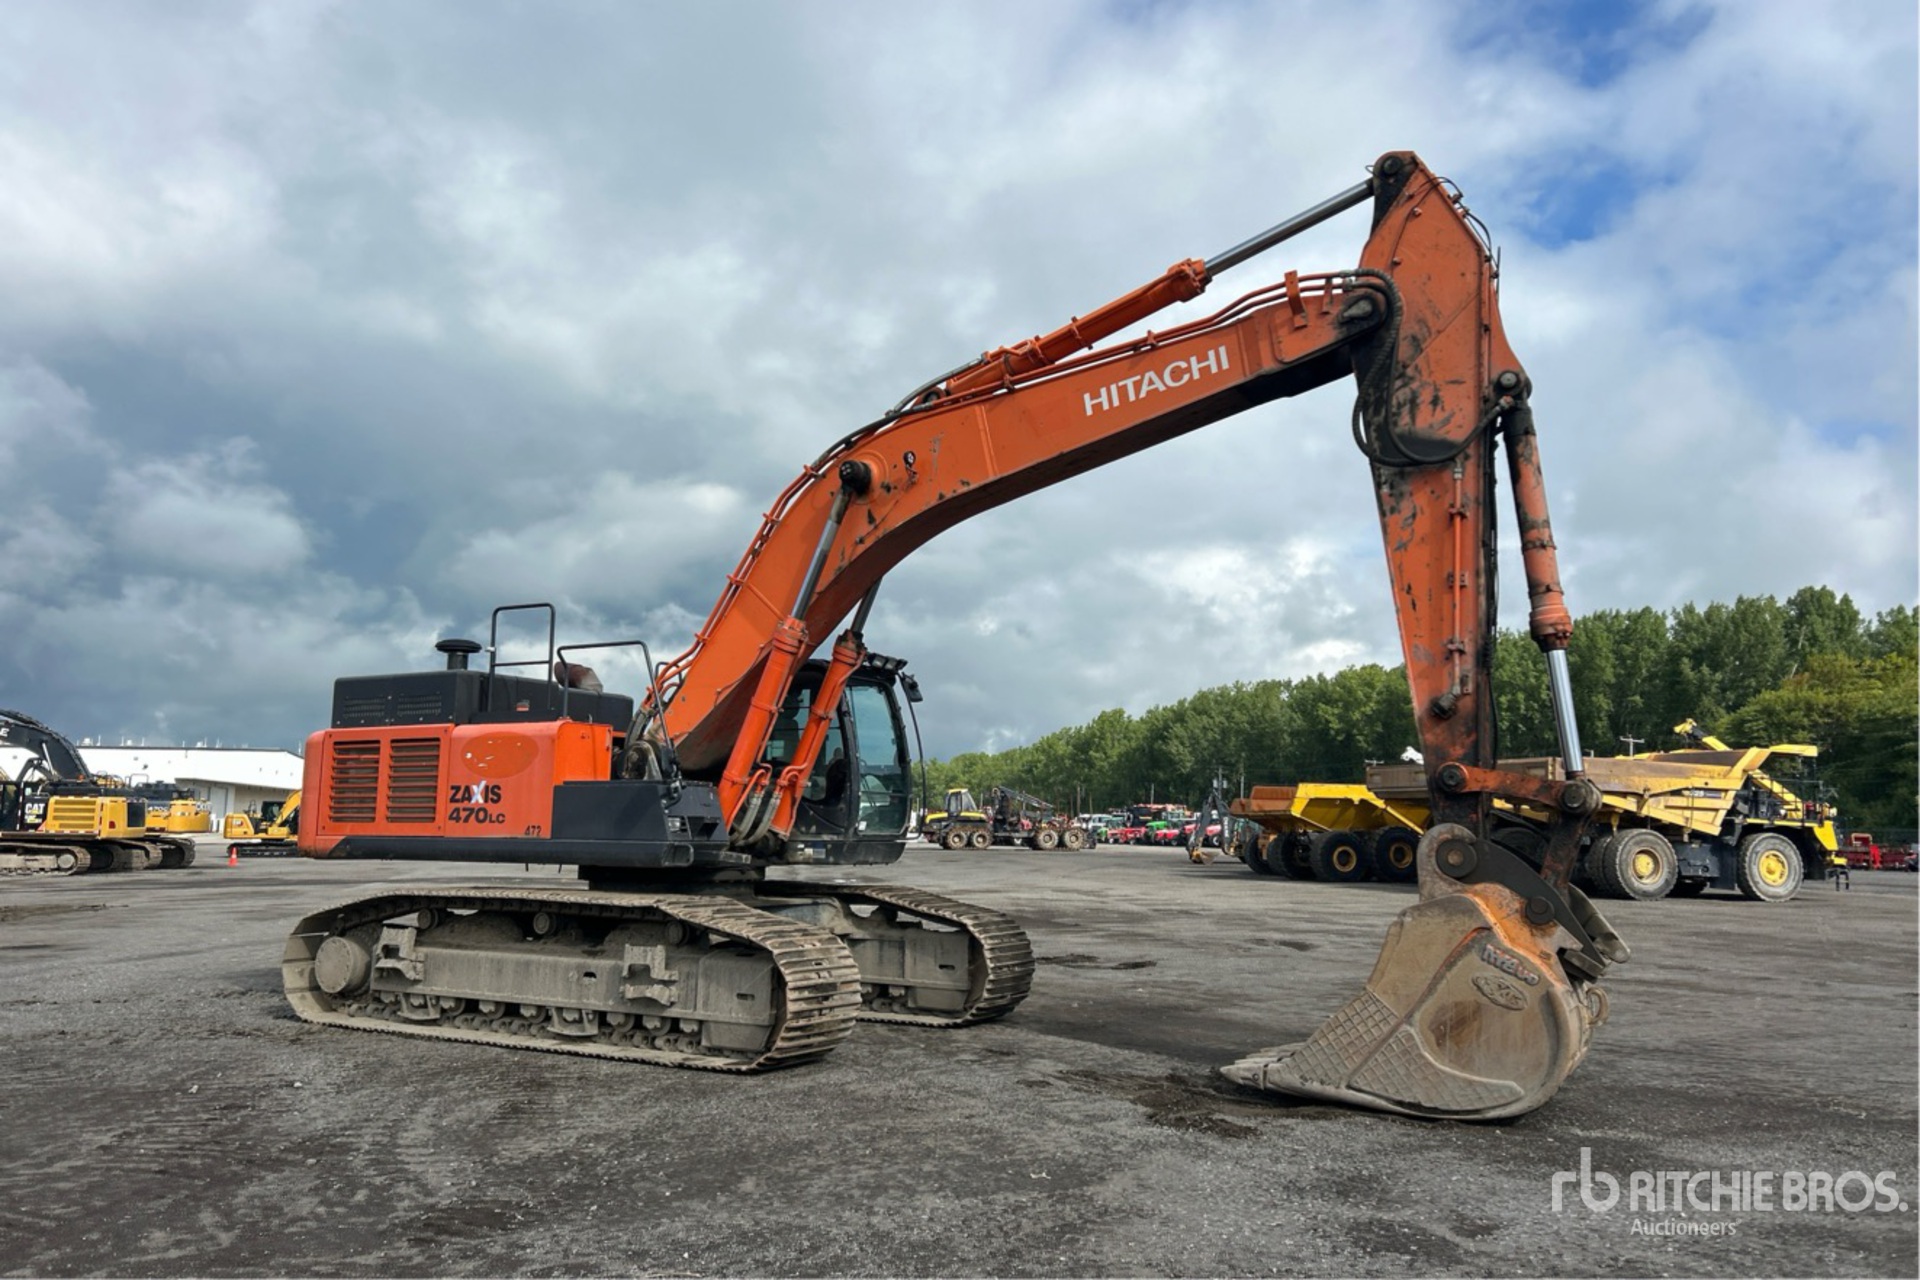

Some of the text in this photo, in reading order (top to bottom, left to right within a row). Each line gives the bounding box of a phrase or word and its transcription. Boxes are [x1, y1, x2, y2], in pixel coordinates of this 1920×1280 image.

[1083, 345, 1230, 416] HITACHI
[449, 780, 502, 804] ZAXIS
[25, 803, 46, 815] CAT
